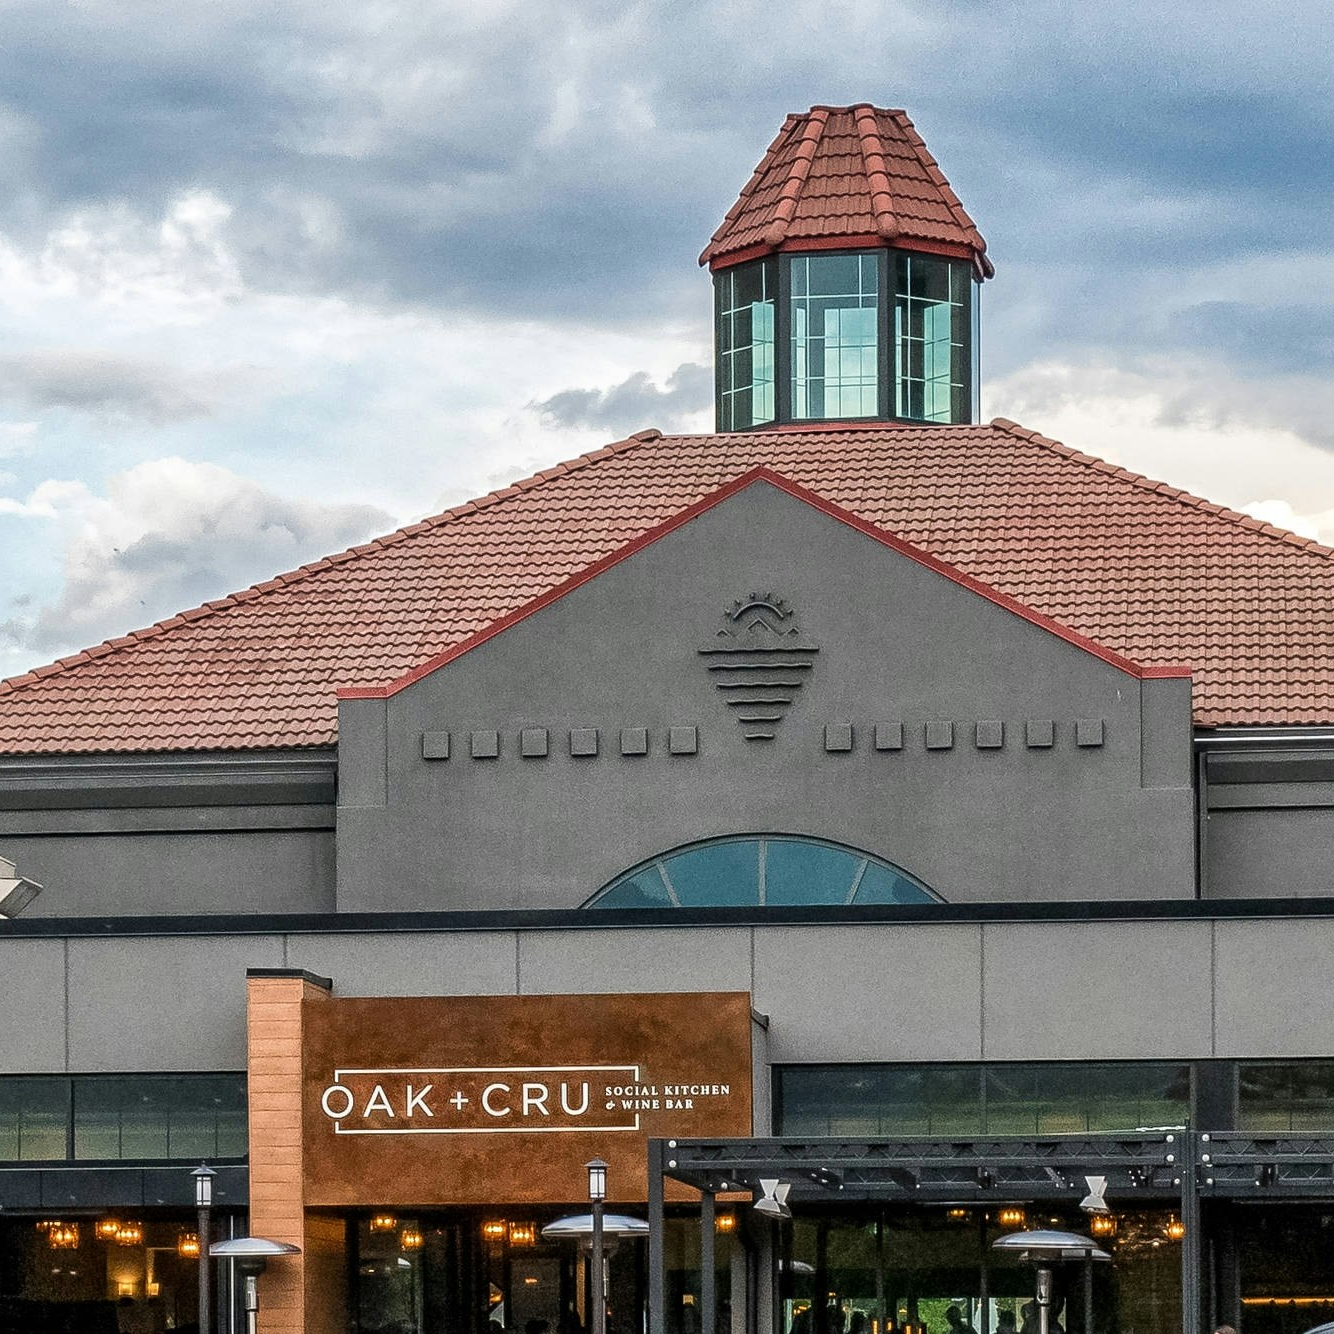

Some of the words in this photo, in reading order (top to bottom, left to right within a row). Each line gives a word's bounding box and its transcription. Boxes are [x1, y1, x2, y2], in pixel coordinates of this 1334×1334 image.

[605, 1086, 659, 1096] SOCIAL
[664, 1084, 730, 1096] KITCHEN
[321, 1083, 435, 1119] OAK
[481, 1082, 589, 1117] CRU
[605, 1100, 616, 1110] &
[621, 1100, 660, 1110] WINE
[665, 1099, 694, 1109] BAR
